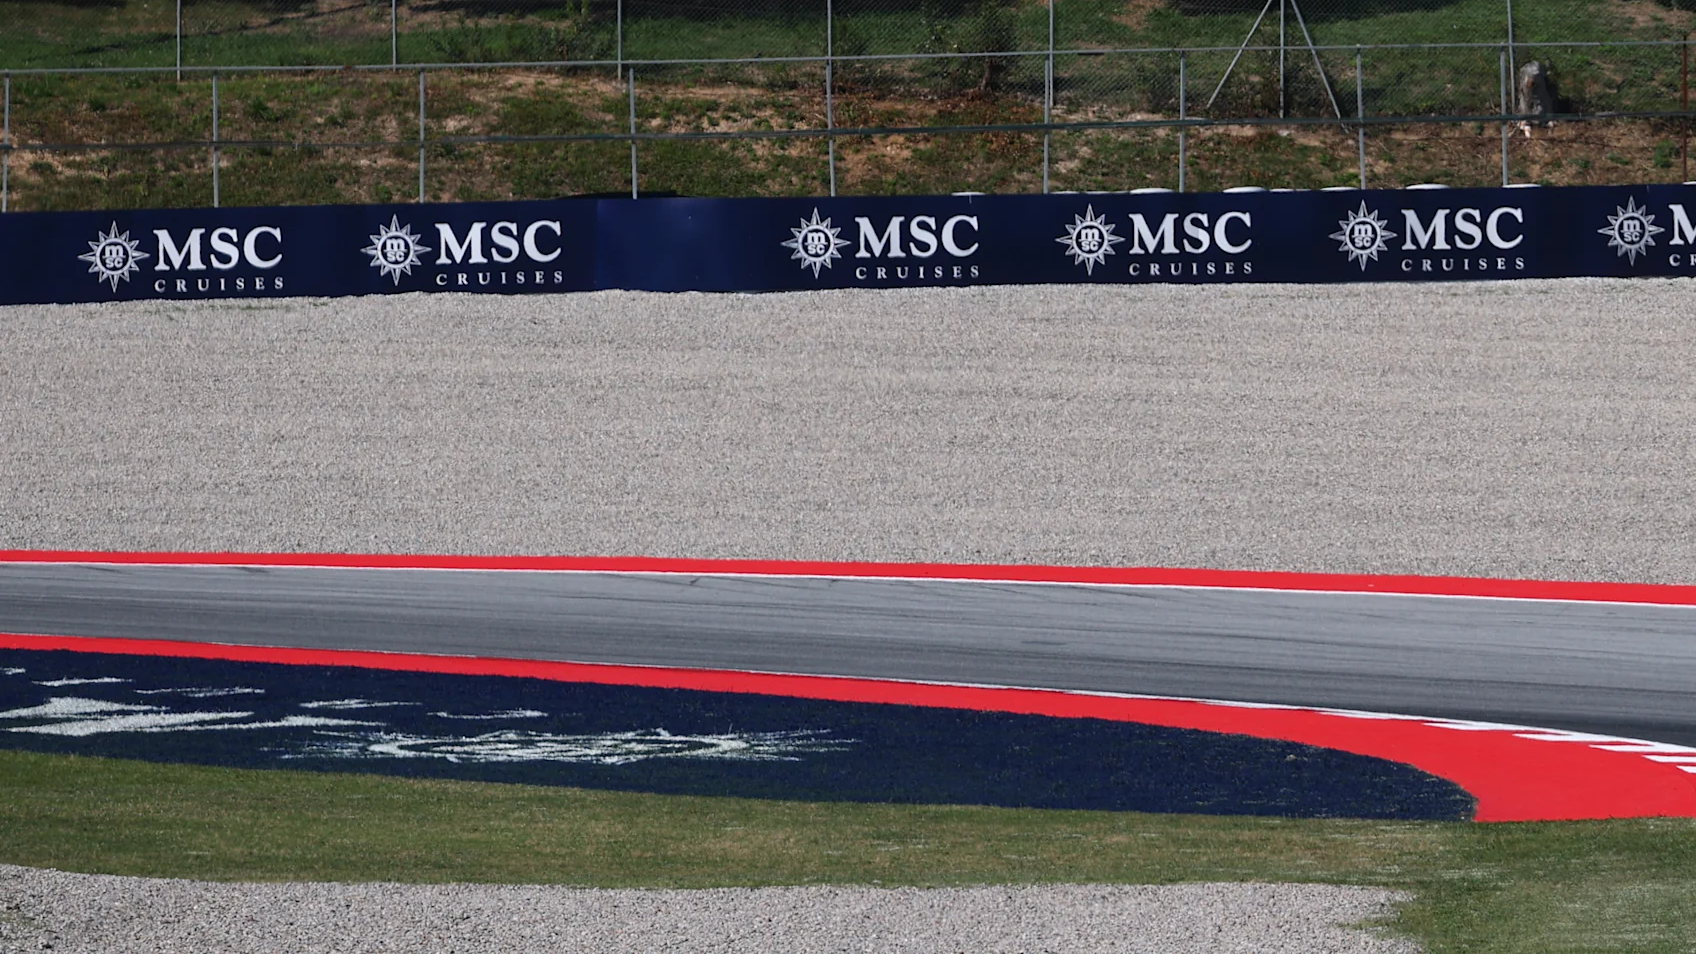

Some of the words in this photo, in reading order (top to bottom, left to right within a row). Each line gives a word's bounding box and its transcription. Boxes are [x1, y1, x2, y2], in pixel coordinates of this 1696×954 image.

[434, 219, 562, 265] MSC
[854, 214, 979, 259] MSC
[1128, 211, 1252, 255] MSC
[1400, 206, 1524, 251] MSC
[152, 225, 283, 272] MSC
[435, 270, 563, 286] CRUISES
[855, 265, 979, 280] CRUISES
[1128, 261, 1252, 276] CRUISES
[1401, 257, 1525, 272] CRUISES
[154, 276, 284, 293] CRUISES
